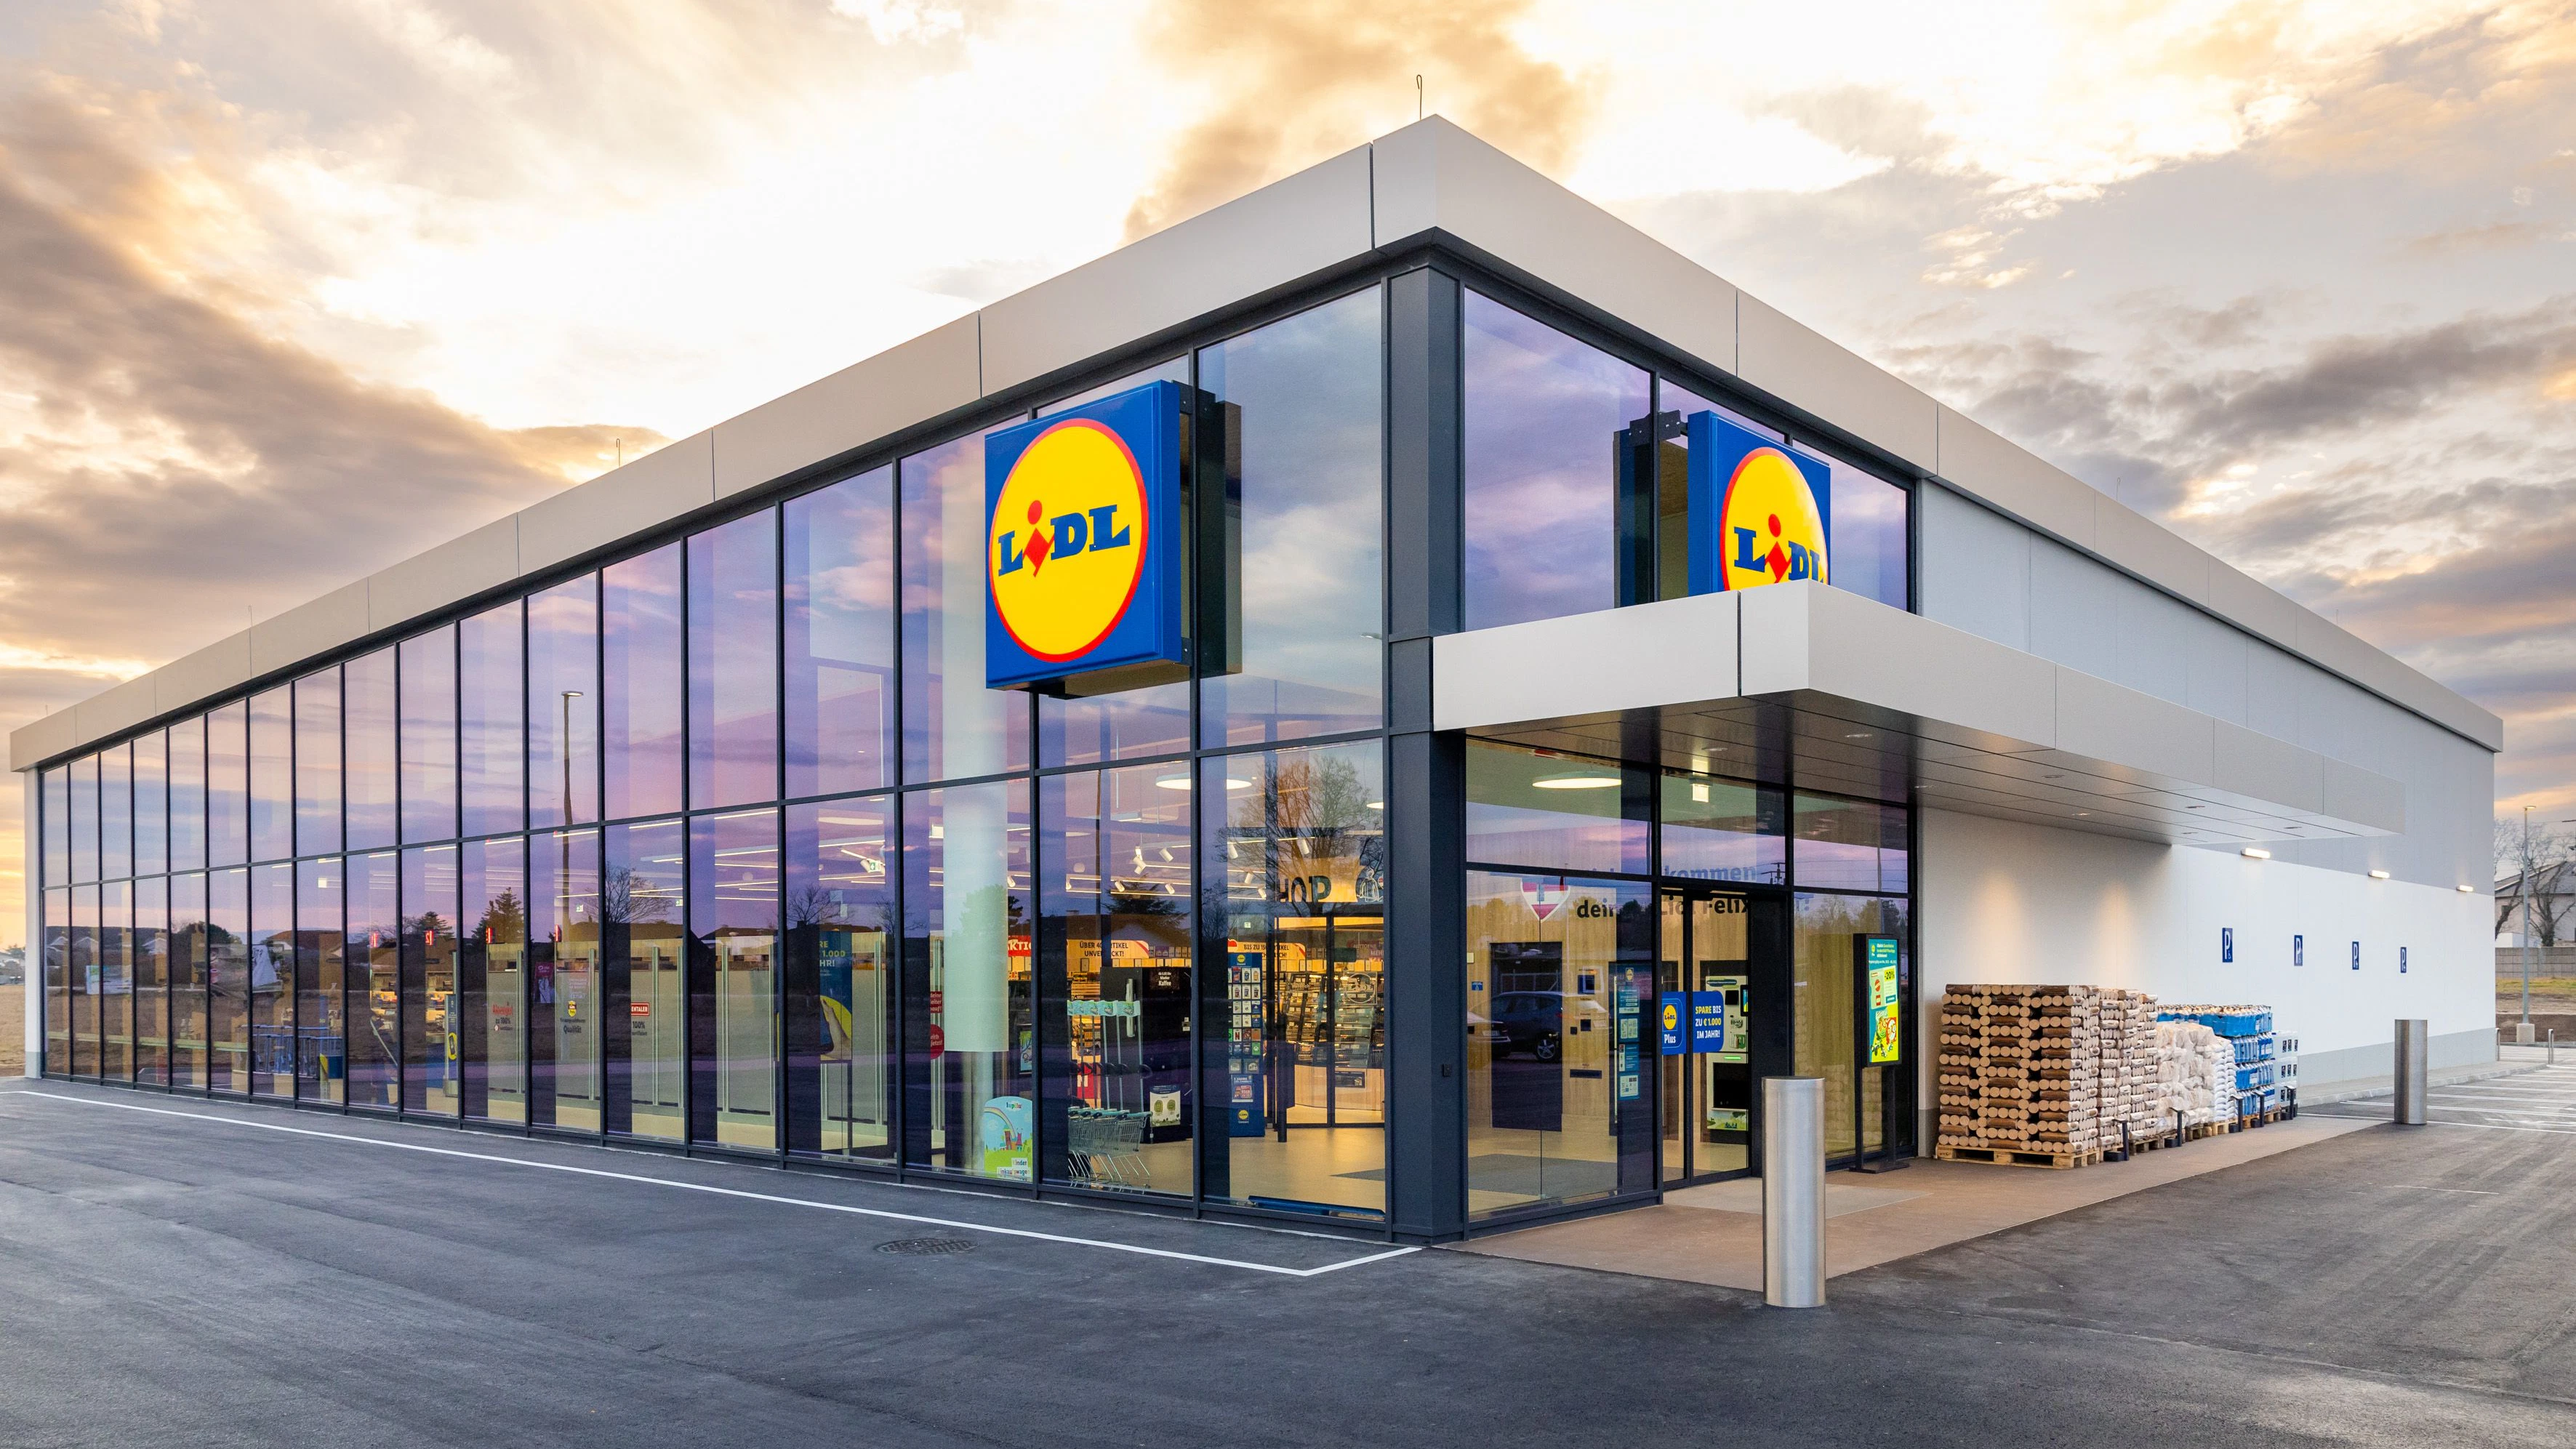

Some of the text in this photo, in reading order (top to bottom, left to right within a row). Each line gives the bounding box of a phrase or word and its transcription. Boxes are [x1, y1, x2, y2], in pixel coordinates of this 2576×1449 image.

[1080, 940, 1095, 949] ÜBER
[2224, 931, 2231, 960] P
[2295, 937, 2301, 963] P
[2353, 943, 2358, 968] P
[2401, 948, 2406, 971] P
[1695, 1005, 1722, 1015] SPARE BIS
[633, 1021, 646, 1029] 100%
[1695, 1018, 1703, 1027] ZU
[1708, 1017, 1722, 1026] 1.000
[1664, 1033, 1677, 1044] Plus
[1696, 1029, 1720, 1039] IM JAHR!
